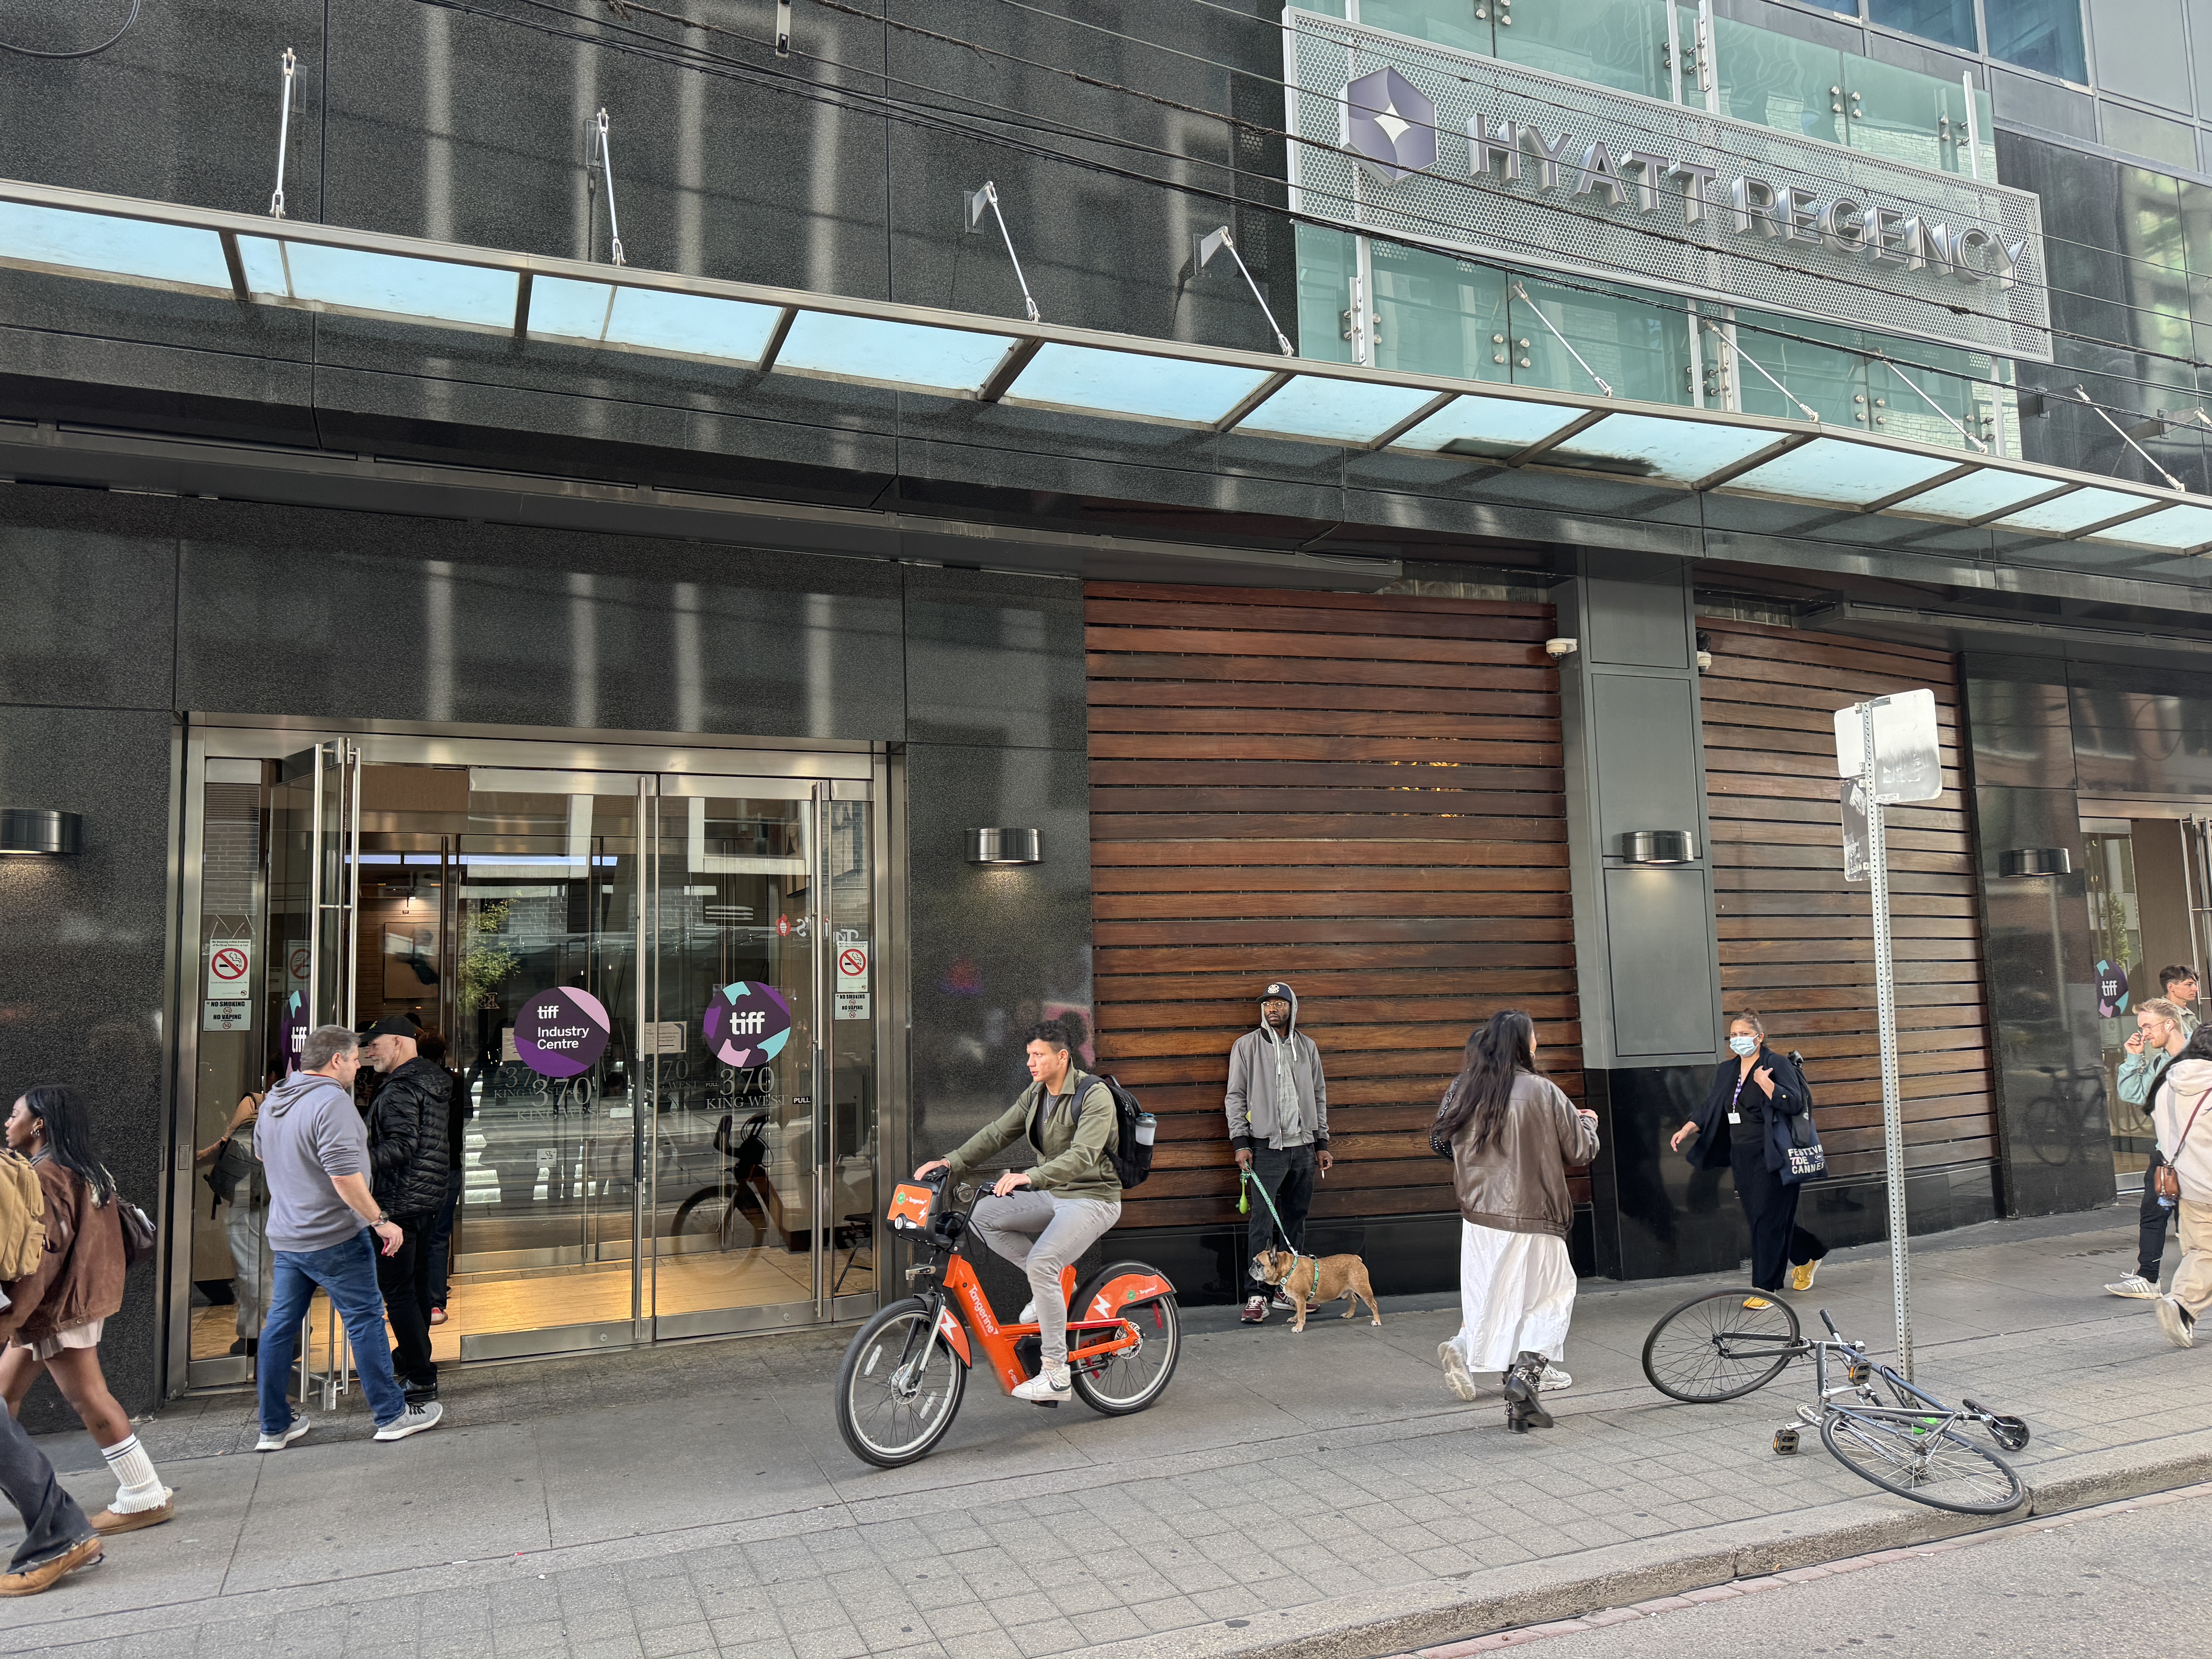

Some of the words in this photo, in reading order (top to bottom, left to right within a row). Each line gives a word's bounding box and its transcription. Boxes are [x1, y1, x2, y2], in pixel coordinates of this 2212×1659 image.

[1467, 113, 1717, 227] HYATT
[1732, 175, 2027, 292] REGENCY
[2102, 981, 2117, 996] tiff
[538, 1005, 559, 1019] tiff
[730, 1012, 765, 1035] tiff
[538, 1026, 589, 1039] Industry
[538, 1039, 579, 1050] Centre
[720, 1067, 775, 1095] 370
[495, 1089, 524, 1098] KING
[532, 1077, 592, 1107] 370
[706, 1097, 744, 1109] KING
[748, 1095, 788, 1106] WEST
[518, 1109, 557, 1120] KING
[561, 1107, 596, 1120] WES
[1792, 1162, 1824, 1175] CANNES
[969, 1283, 995, 1334] Tangerine
